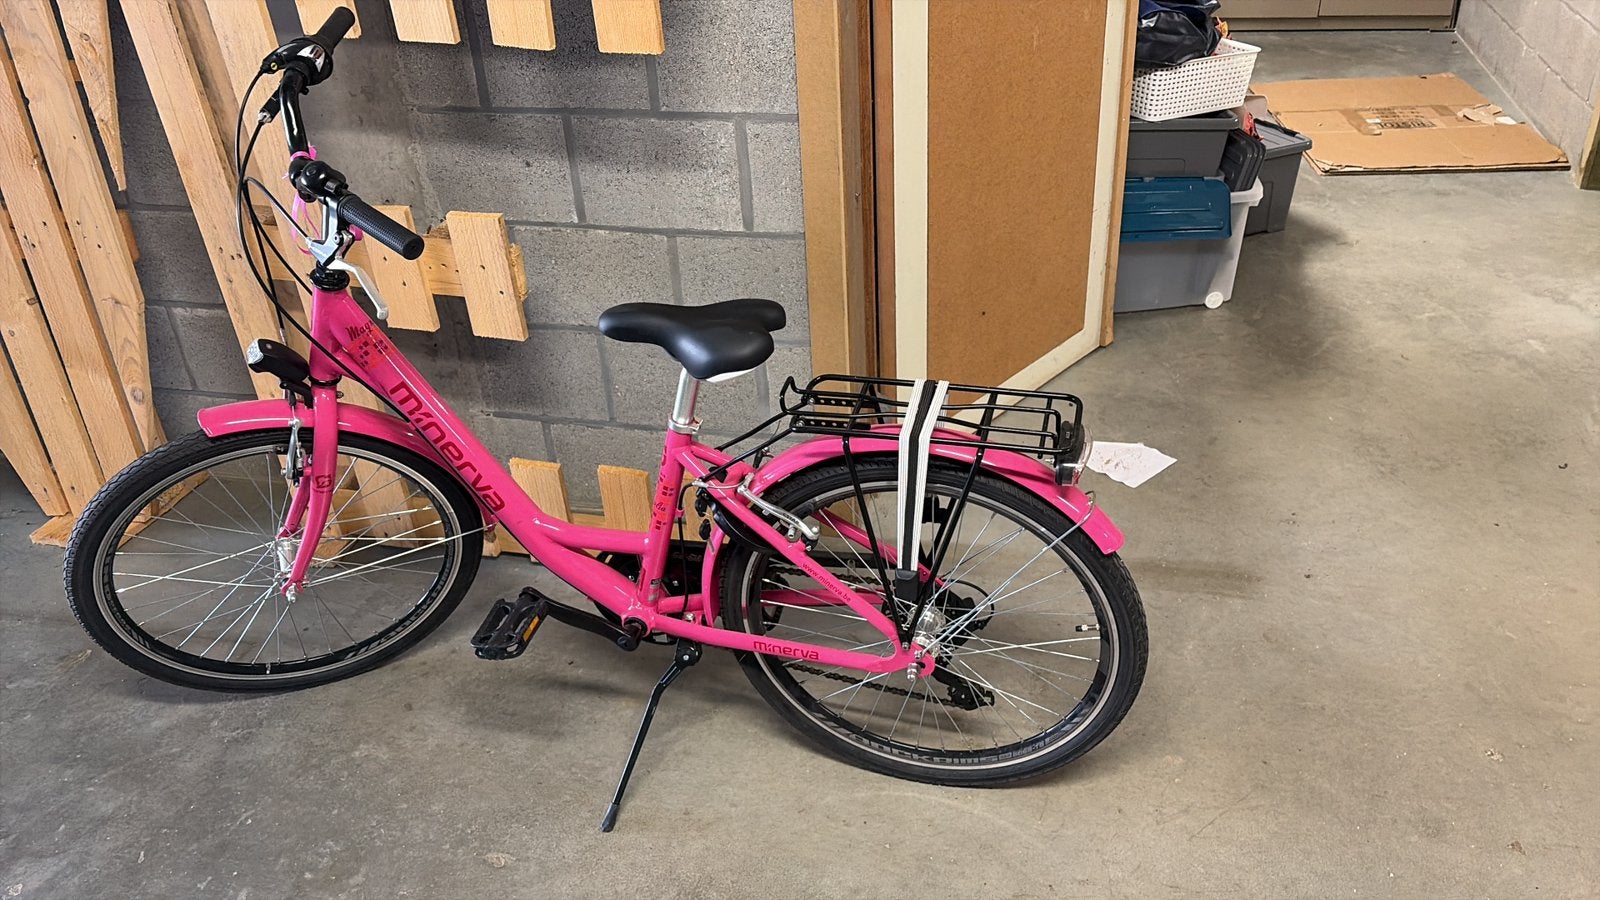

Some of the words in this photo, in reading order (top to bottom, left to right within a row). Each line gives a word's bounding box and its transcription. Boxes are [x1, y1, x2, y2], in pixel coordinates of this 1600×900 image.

[346, 320, 373, 341] Mag
[389, 381, 506, 513] minerva
[803, 563, 851, 601] www.minerva.be
[753, 639, 820, 661] minerva
